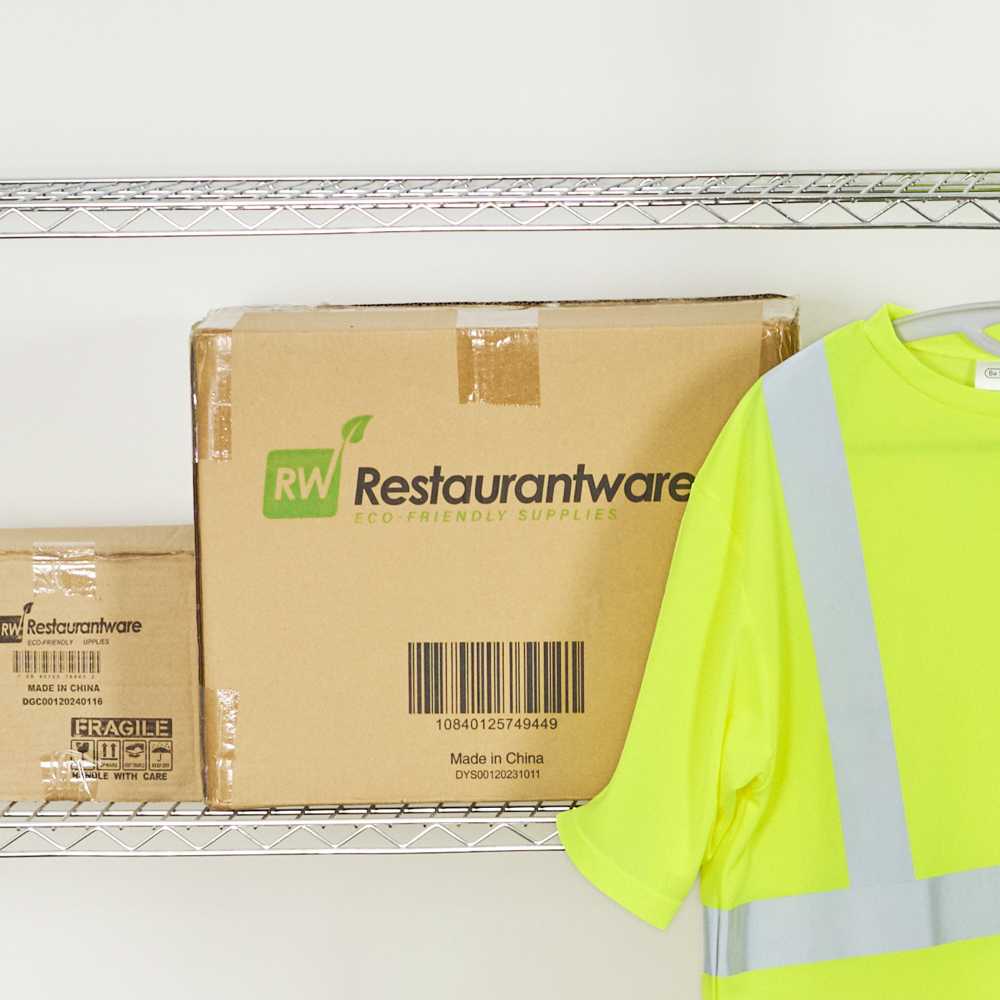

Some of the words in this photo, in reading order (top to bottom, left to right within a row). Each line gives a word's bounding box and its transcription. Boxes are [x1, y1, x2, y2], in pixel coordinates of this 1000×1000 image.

[274, 465, 333, 502] RW
[354, 464, 696, 505] Restaurantware
[519, 508, 617, 521] SUPPLIES
[0, 622, 21, 638] RW
[27, 618, 142, 635] Restaurantware
[27, 684, 54, 692] MADE
[57, 684, 67, 692] IN
[70, 684, 100, 692] CHINA
[74, 718, 169, 737] FRAGILE
[436, 717, 558, 731] 10840125749449
[450, 752, 487, 765] Made
[491, 752, 502, 765] in
[506, 751, 544, 765] China
[114, 772, 138, 781] WITH
[143, 772, 168, 781] CARE
[455, 769, 540, 780] DYS00120231011
